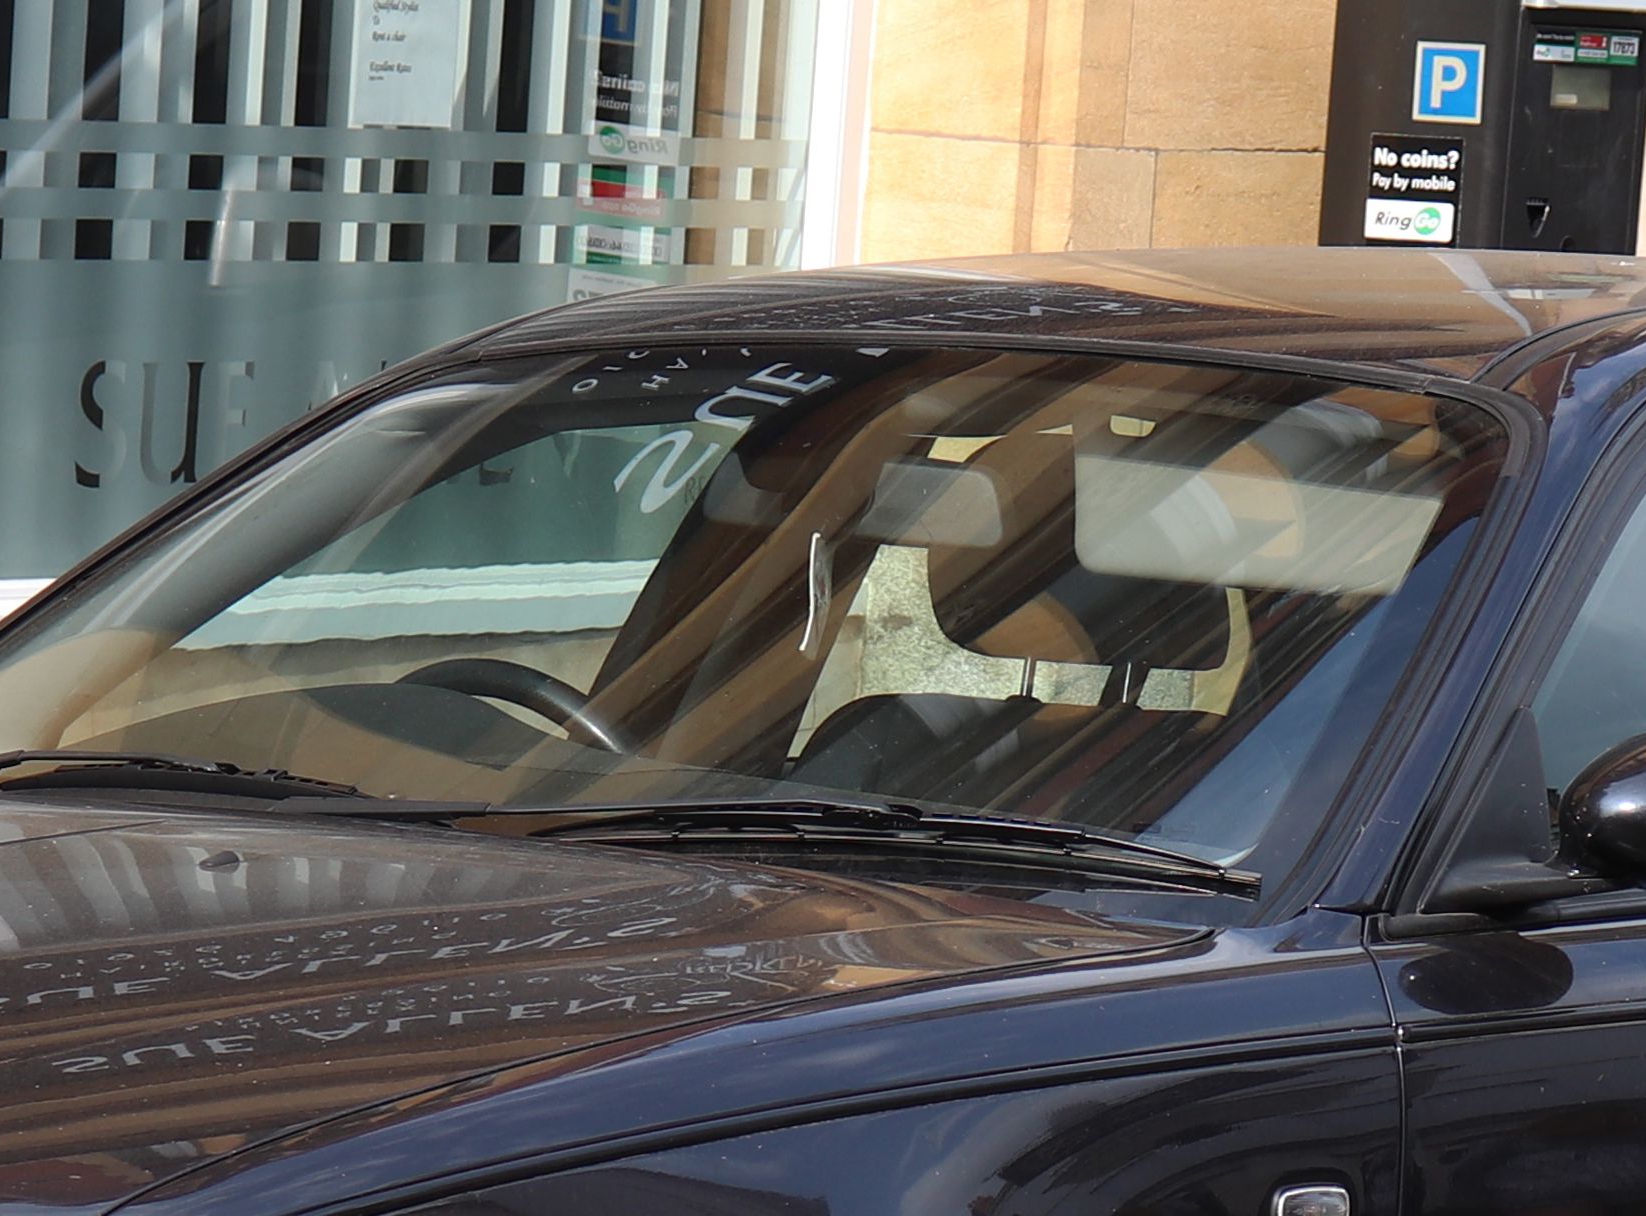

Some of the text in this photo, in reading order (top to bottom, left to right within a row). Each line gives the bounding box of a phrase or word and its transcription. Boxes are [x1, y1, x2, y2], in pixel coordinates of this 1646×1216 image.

[1429, 54, 1468, 110] P
[1373, 147, 1460, 169] No coins?
[1372, 172, 1456, 192] Pay by mobile
